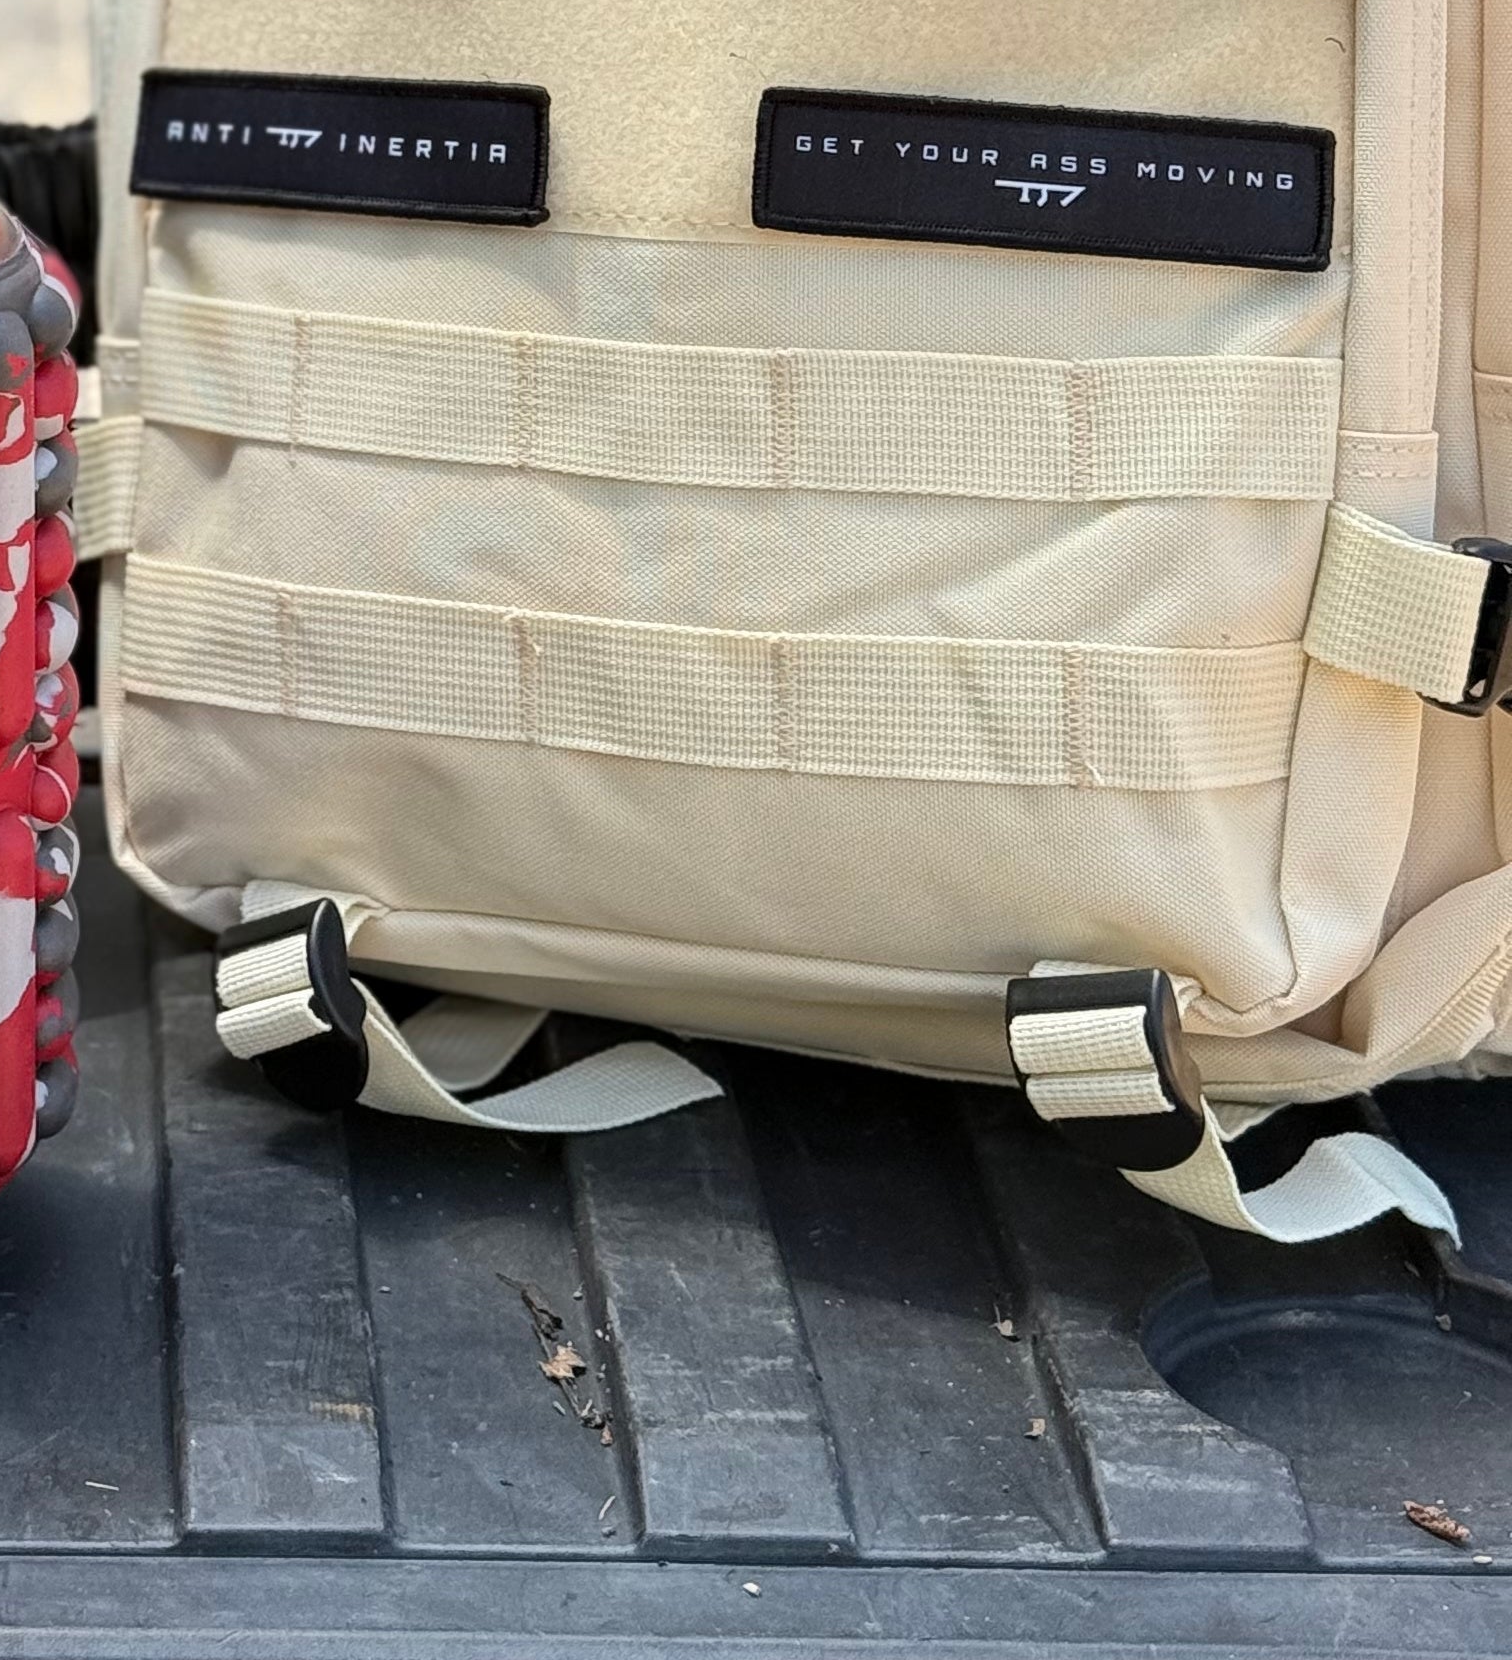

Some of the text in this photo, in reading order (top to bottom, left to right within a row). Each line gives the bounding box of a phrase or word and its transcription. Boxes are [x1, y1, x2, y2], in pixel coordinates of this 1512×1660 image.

[166, 120, 508, 165] ANTI INERTIA
[795, 135, 1296, 192] GET YOUR ASS MOVING
